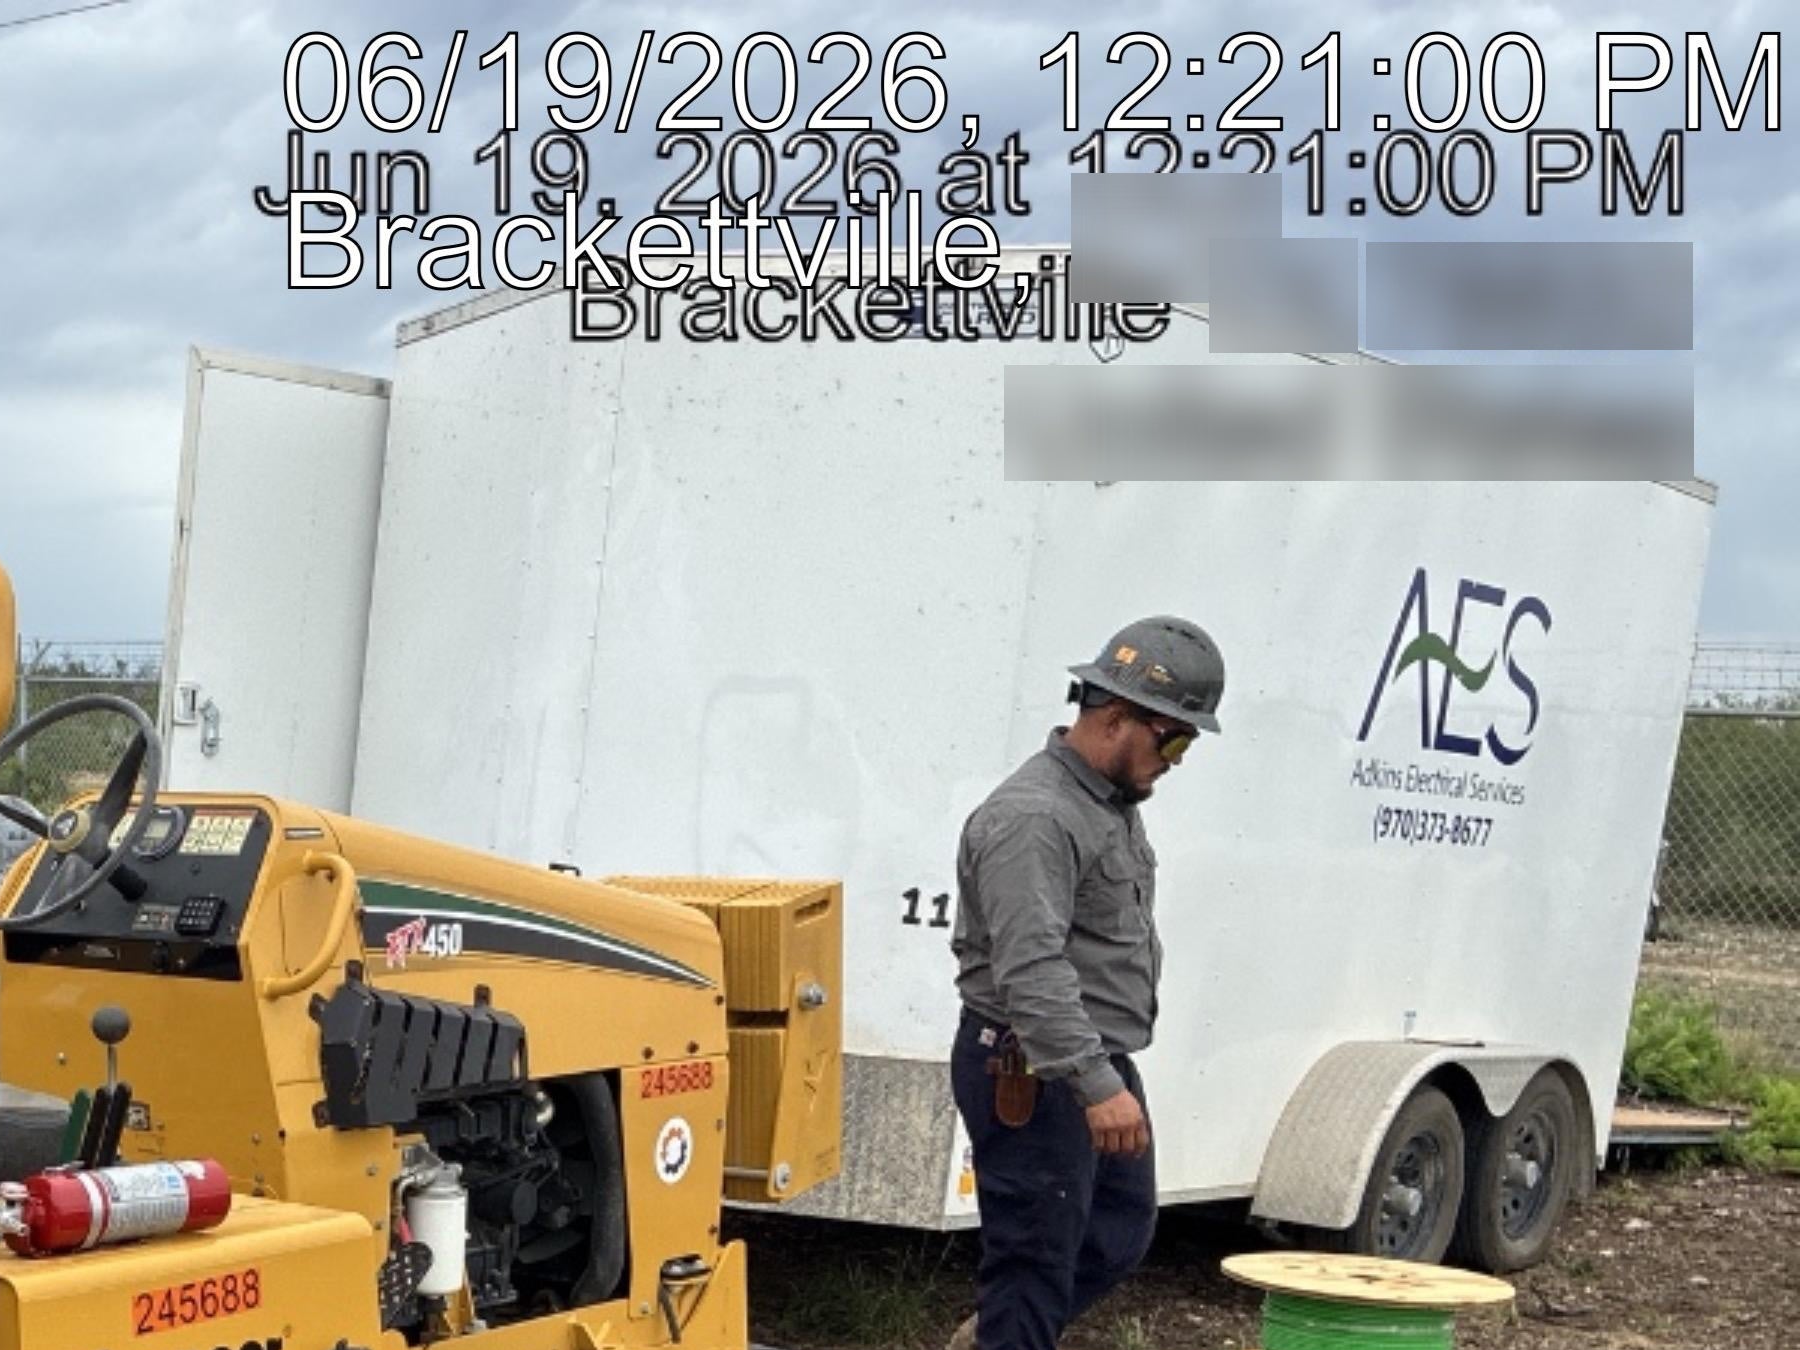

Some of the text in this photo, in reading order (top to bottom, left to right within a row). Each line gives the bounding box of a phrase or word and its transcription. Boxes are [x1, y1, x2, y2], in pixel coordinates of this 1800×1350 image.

[1355, 566, 1553, 766] AES
[1350, 757, 1526, 806] Adkins Electrical Services
[1373, 802, 1495, 847] (970)373-8677
[901, 887, 951, 928] 11
[641, 1061, 712, 1099] 245688
[136, 1268, 260, 1335] 245688
